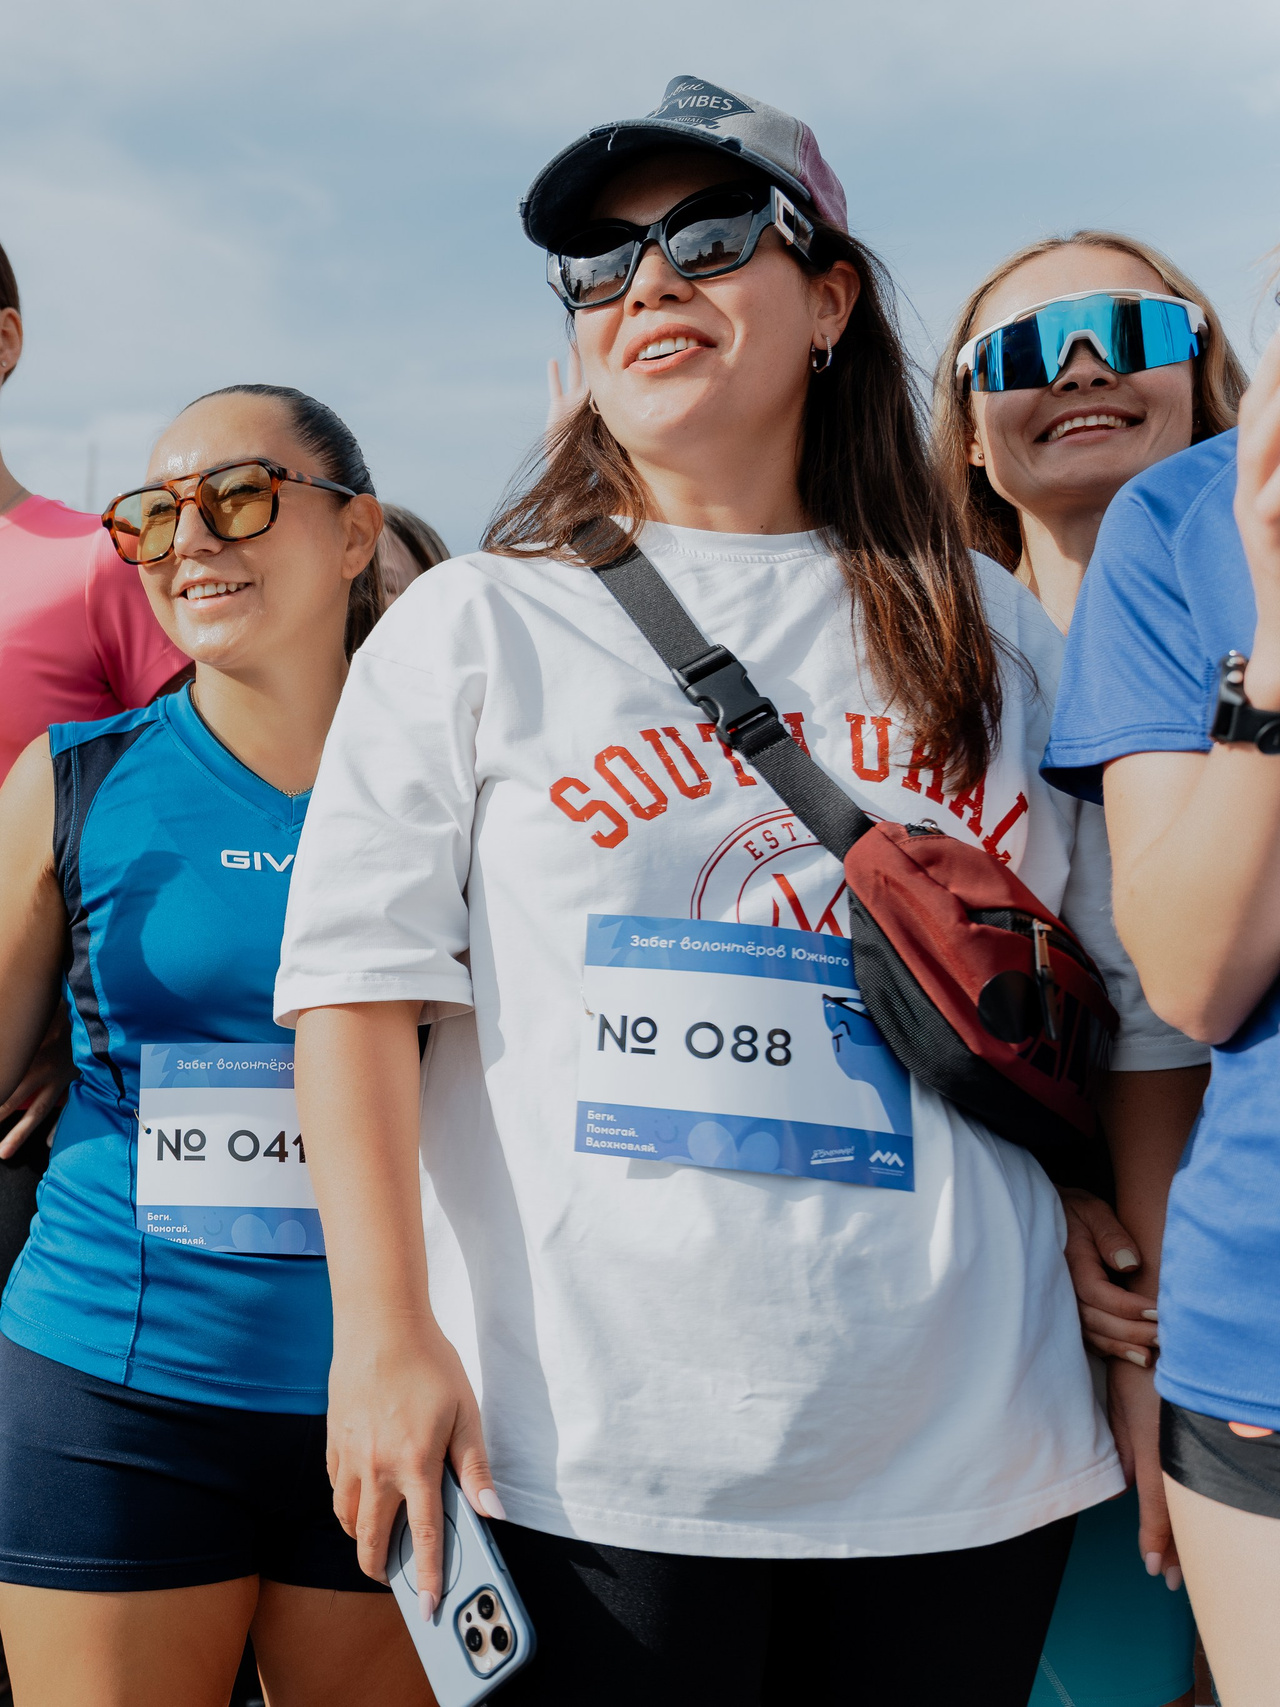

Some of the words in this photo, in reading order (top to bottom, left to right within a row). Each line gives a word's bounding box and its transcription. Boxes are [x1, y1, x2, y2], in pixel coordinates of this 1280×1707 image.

[677, 95, 734, 111] VIBES
[743, 822, 812, 861] EST.
[630, 934, 676, 950] Забег
[680, 935, 787, 959] волонтёров
[791, 947, 850, 968] Южного
[685, 1021, 792, 1067] 088
[176, 1059, 214, 1070] Забег
[587, 1110, 617, 1123] Беги.
[586, 1123, 639, 1138] Помогай.
[227, 1129, 307, 1164] 041
[585, 1137, 658, 1154] Вдохновляй.
[147, 1212, 172, 1221] Беги.
[147, 1223, 191, 1233] Помогай.
